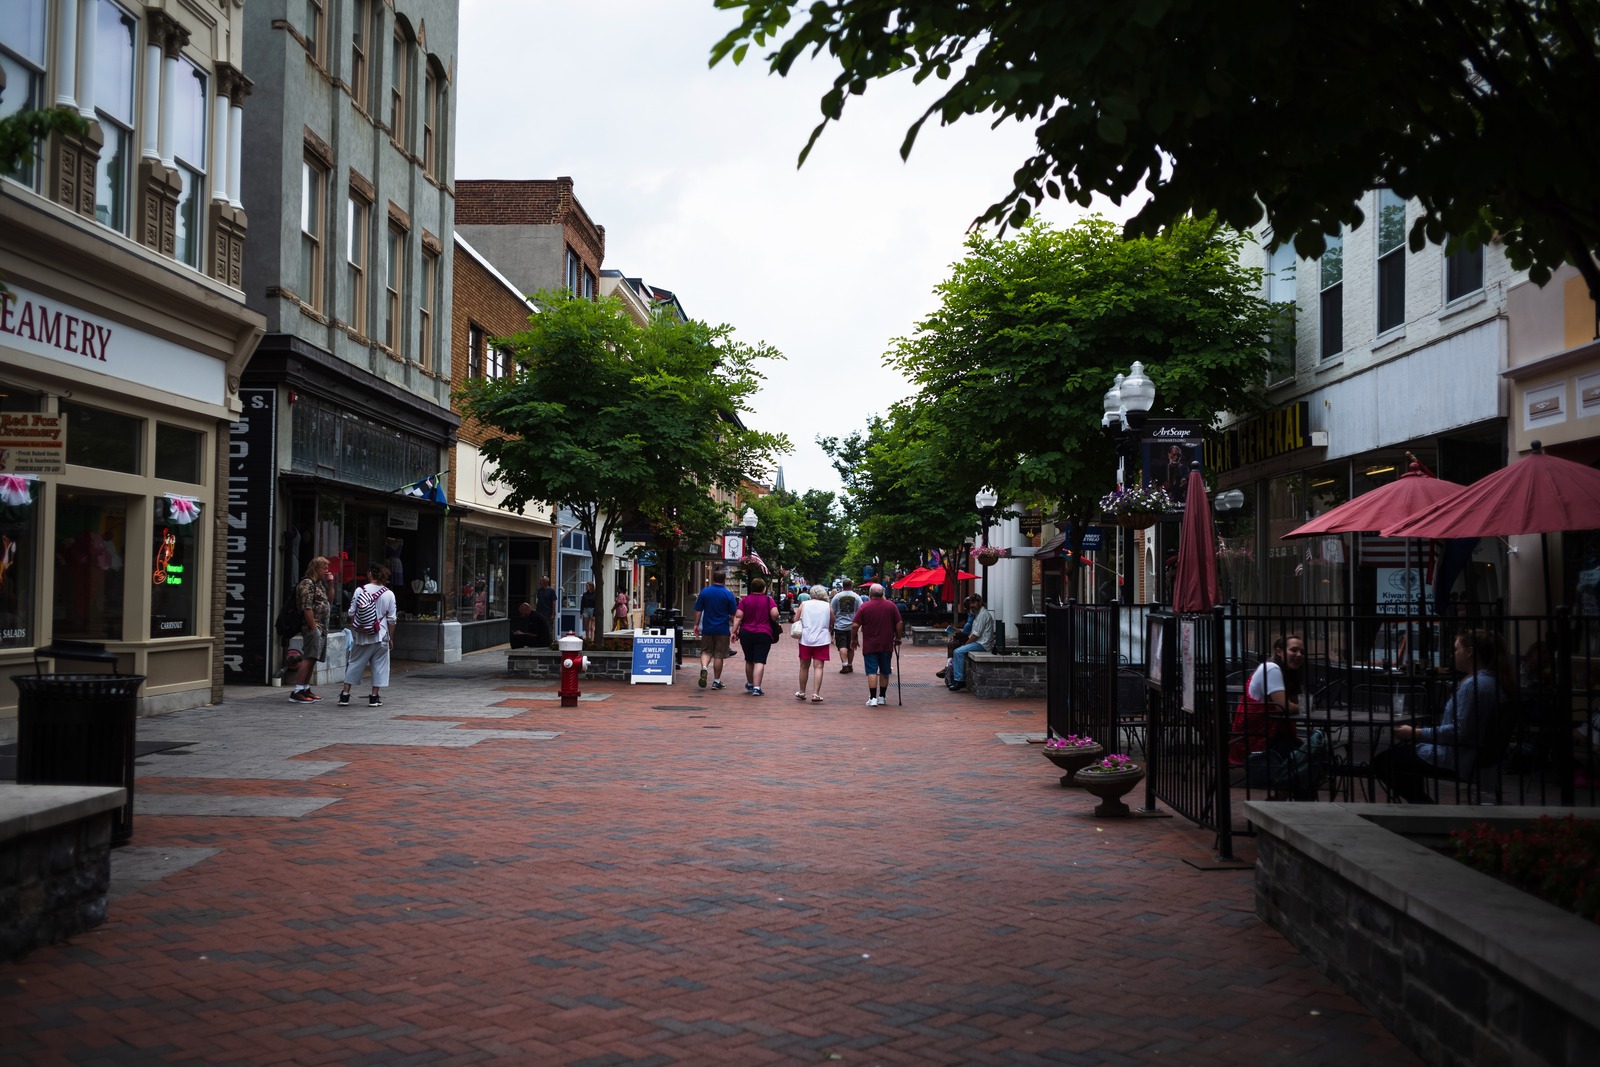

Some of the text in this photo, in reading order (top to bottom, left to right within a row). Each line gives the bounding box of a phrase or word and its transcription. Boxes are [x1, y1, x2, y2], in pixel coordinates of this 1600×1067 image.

[1, 414, 58, 426] Red Fox
[1152, 426, 1191, 438] ArtScape
[1239, 401, 1304, 465] GENERAL
[160, 621, 184, 630] CARRYOUT
[2, 629, 26, 638] SALADS
